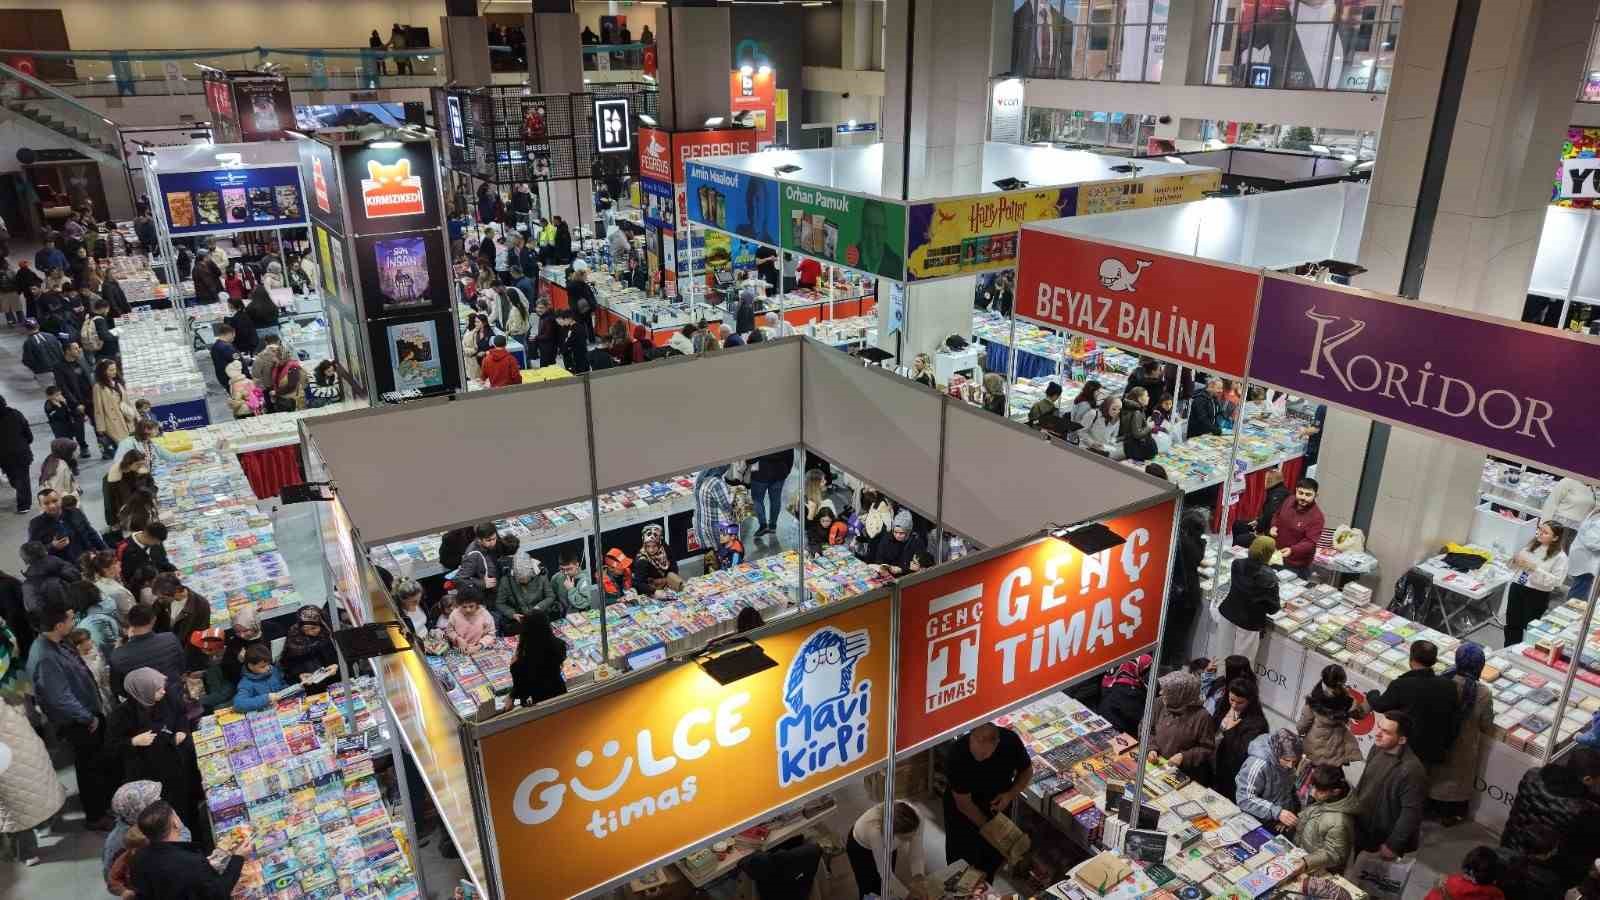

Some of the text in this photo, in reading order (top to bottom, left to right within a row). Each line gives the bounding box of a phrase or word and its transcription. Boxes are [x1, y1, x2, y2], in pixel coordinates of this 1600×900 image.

[641, 154, 670, 175] PEGASUS
[681, 141, 750, 163] PEGASUS
[691, 164, 739, 189] Amin Maalouf
[786, 185, 849, 213] Orhan Pamuk
[967, 196, 1027, 233] Harry Potter
[1036, 282, 1217, 364] BEYAZ BALİNA
[997, 527, 1150, 627] GENÇ
[926, 602, 983, 638] GENÇ
[994, 588, 1145, 685] TİMAŞ
[779, 682, 869, 748] Mavi
[512, 692, 752, 826] GÜLCE
